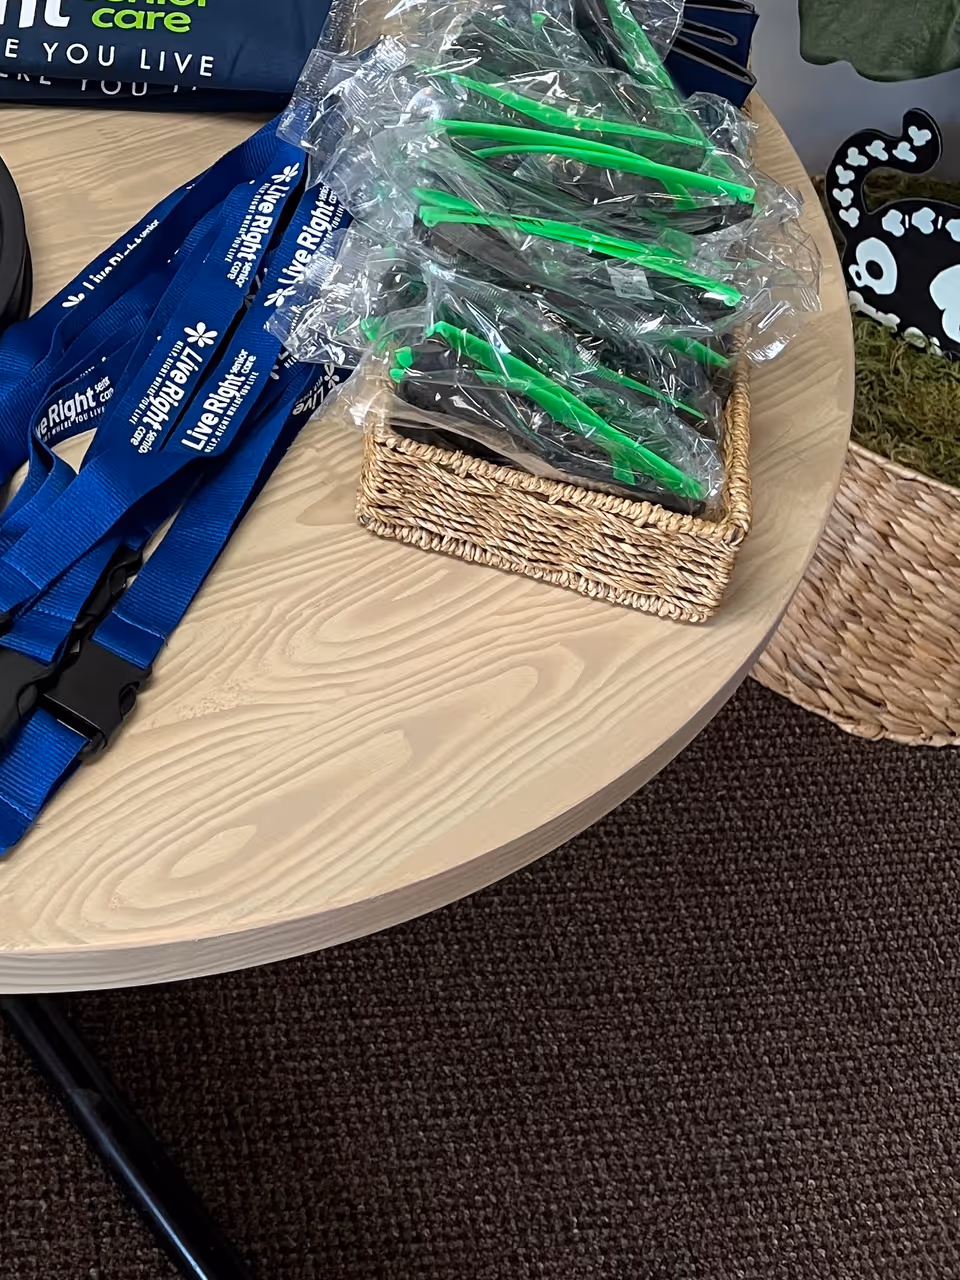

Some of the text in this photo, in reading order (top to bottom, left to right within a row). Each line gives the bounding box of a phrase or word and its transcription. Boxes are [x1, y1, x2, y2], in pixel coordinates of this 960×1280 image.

[91, 6, 192, 33] care
[44, 42, 115, 67] YOU
[140, 48, 214, 77] LIVE
[237, 185, 290, 261] Live Right
[142, 346, 203, 431] Live Right
[181, 374, 245, 450] Live Right
